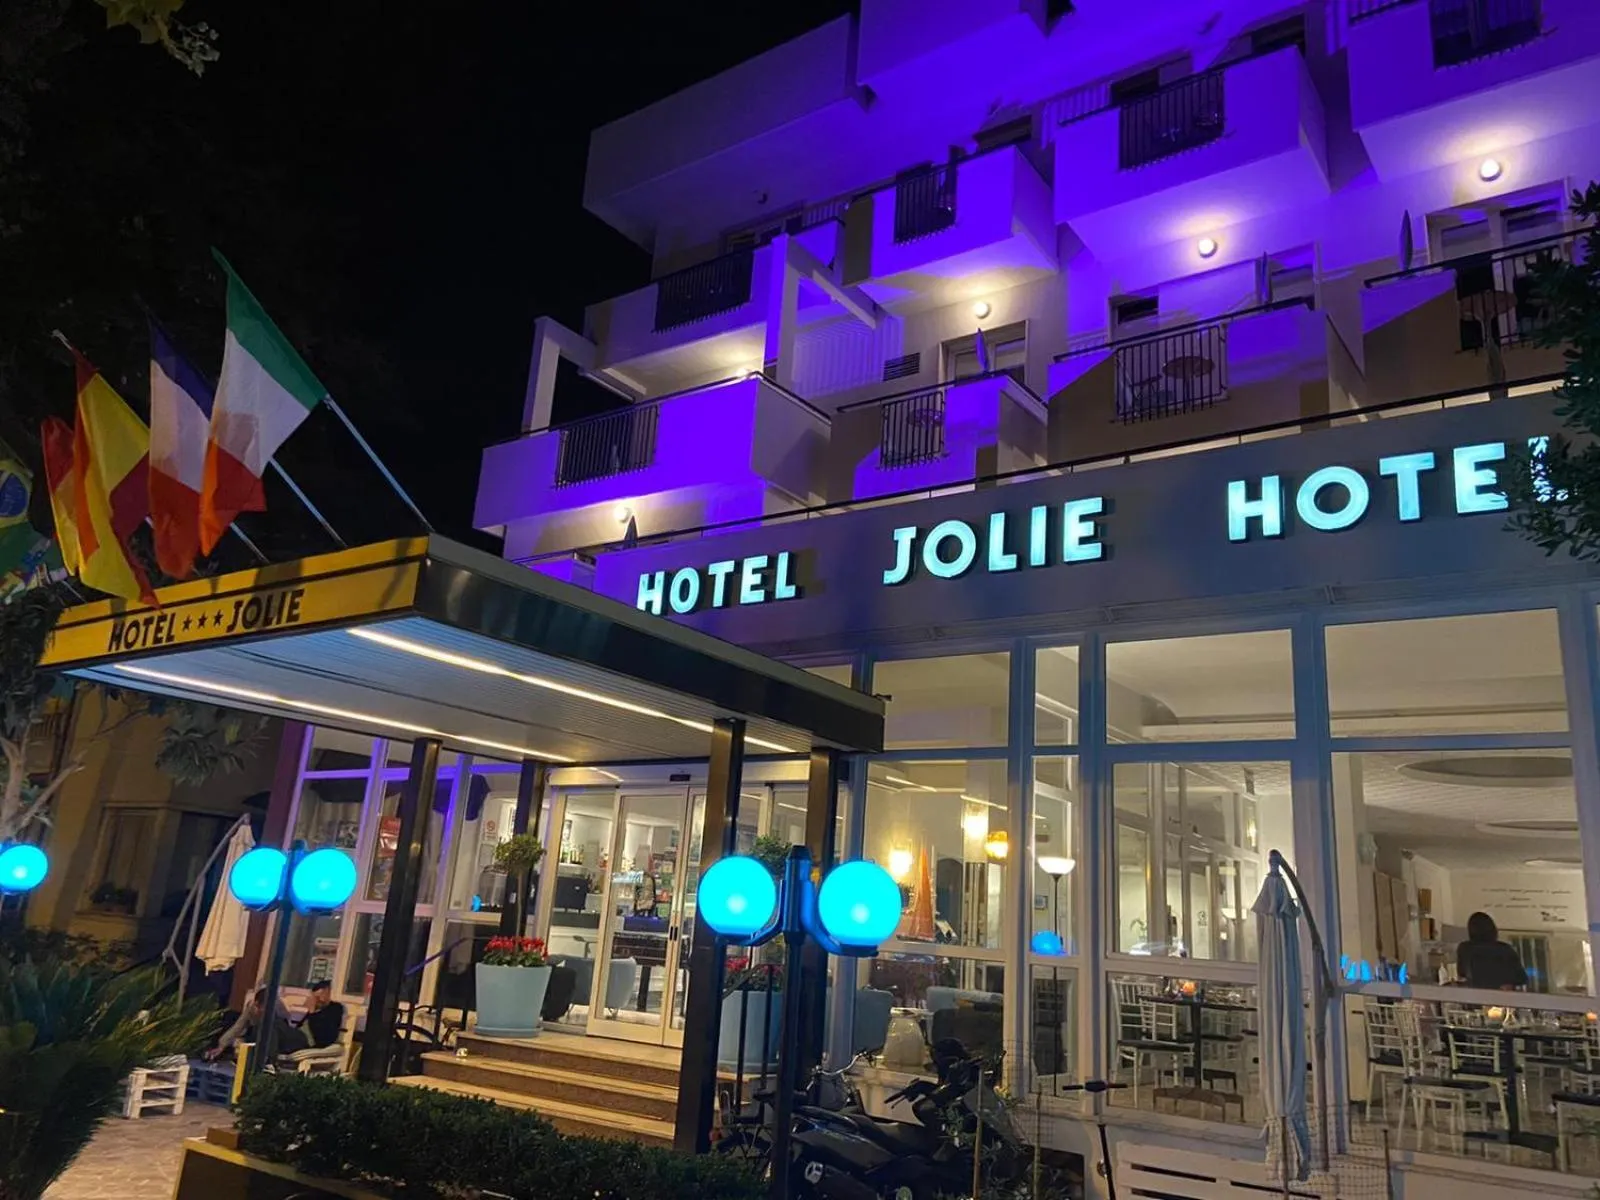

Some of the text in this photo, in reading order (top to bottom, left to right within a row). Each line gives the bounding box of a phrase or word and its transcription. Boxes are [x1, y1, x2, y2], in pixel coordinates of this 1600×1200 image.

[637, 552, 796, 615] HOTEL
[883, 496, 1105, 585] JOLIE
[108, 589, 303, 652] HOTEL JOLIE
